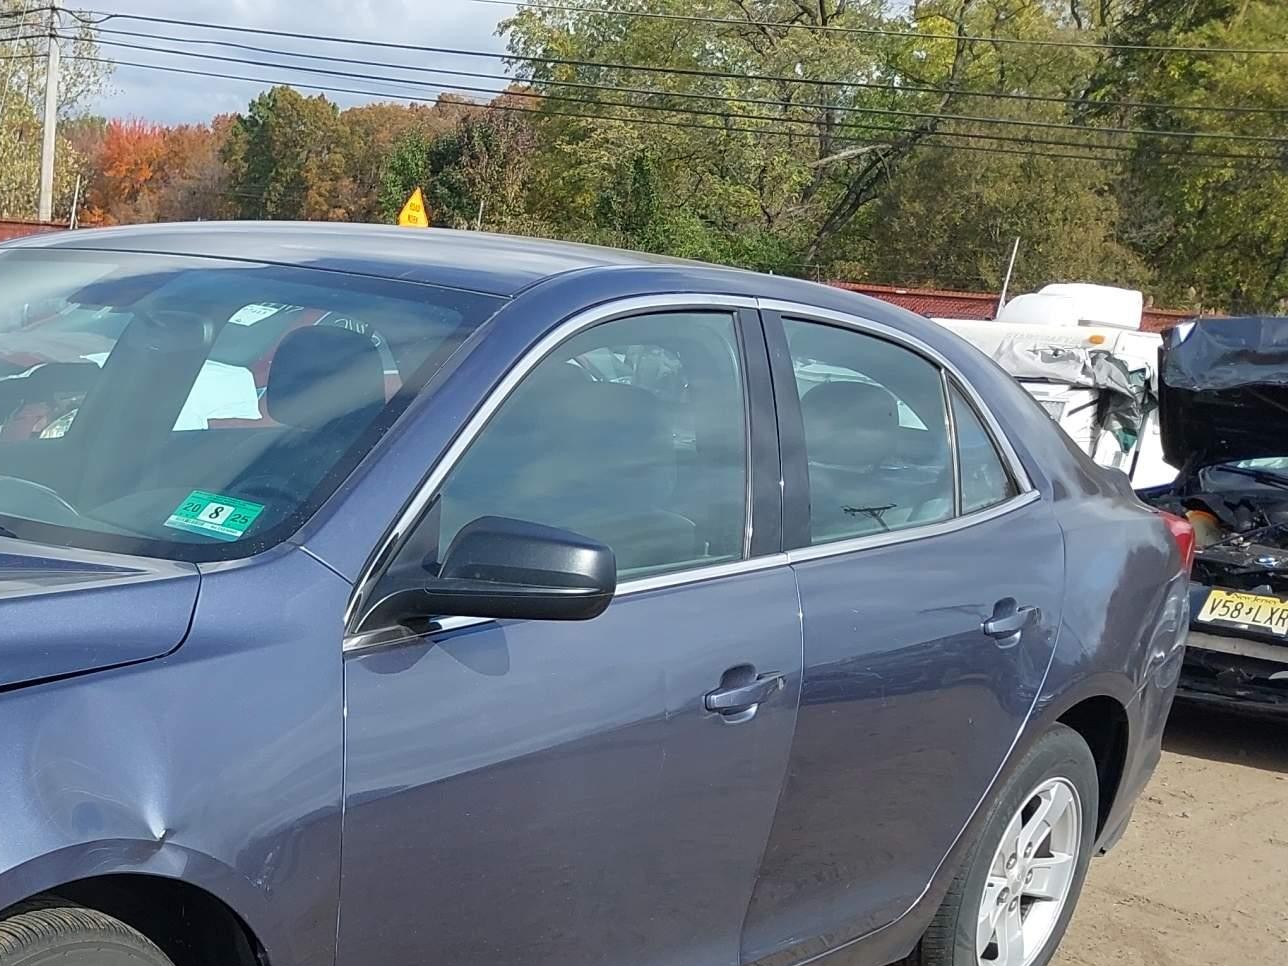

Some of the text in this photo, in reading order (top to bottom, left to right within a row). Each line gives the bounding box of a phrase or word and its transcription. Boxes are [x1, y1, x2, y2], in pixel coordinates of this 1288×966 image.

[183, 502, 202, 513] 20
[208, 506, 225, 520] 8
[230, 513, 249, 524] 25
